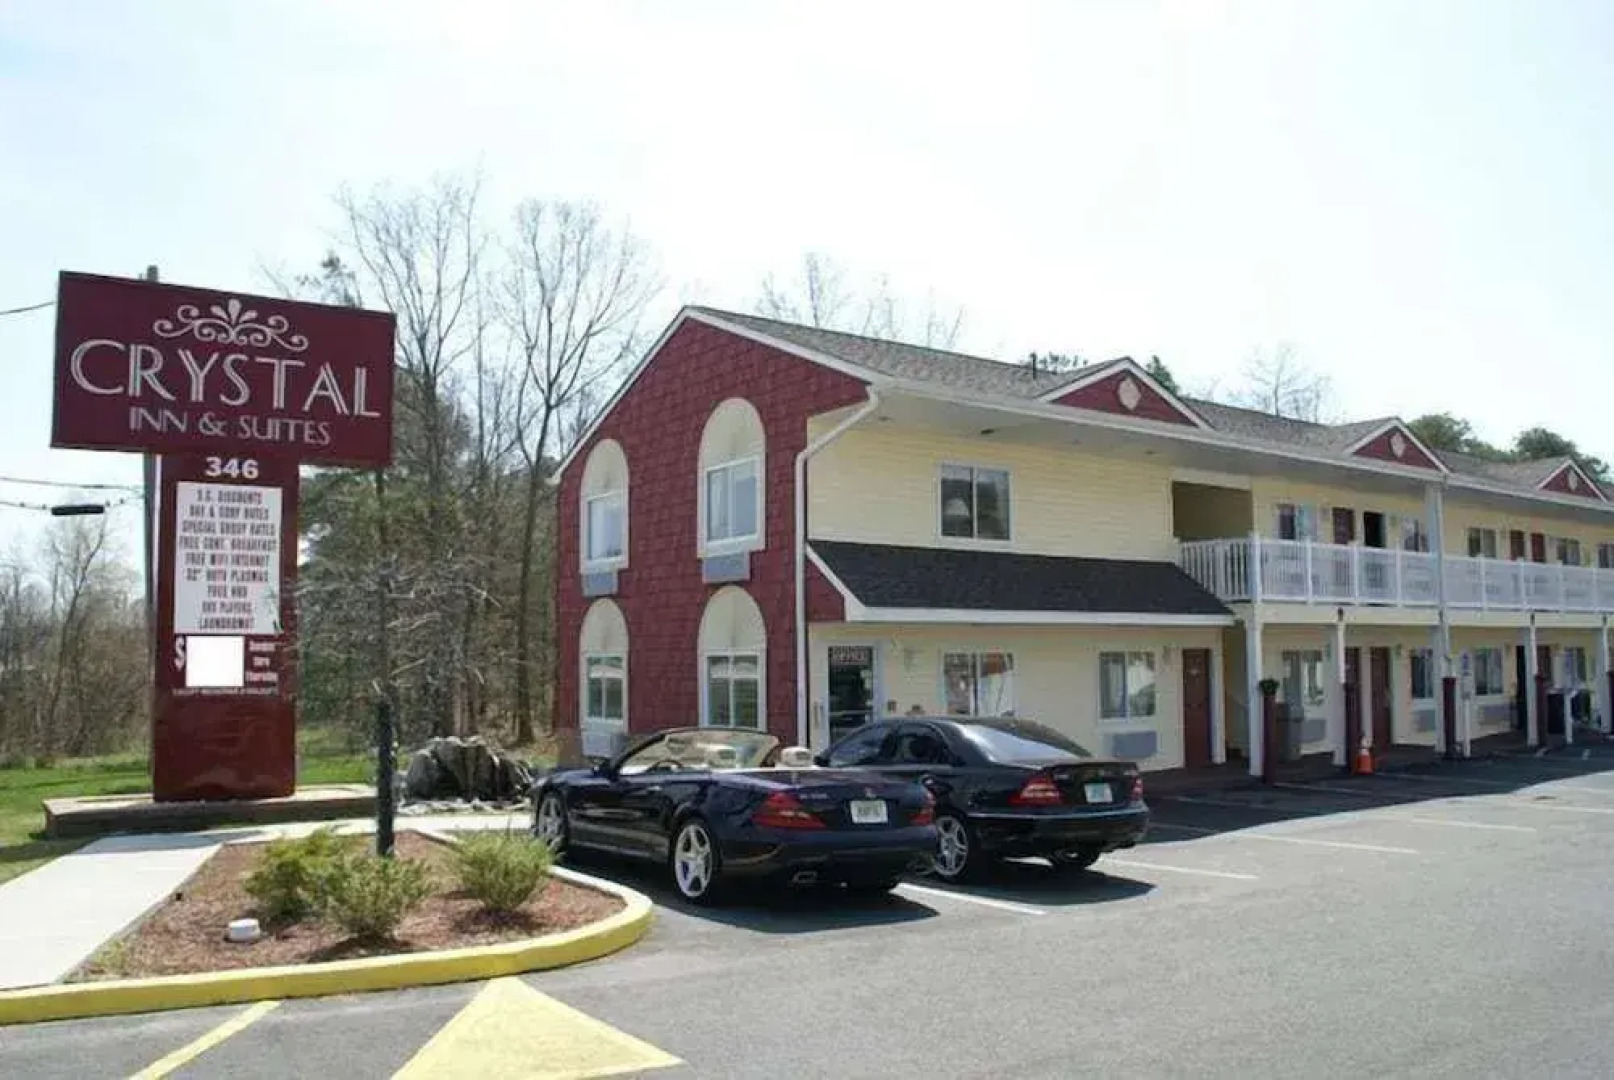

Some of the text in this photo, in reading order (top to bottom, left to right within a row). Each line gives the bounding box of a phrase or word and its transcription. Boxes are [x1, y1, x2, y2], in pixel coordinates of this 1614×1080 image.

[70, 338, 382, 418] CRYSTAL
[130, 406, 331, 446] INN & SUITES
[205, 457, 259, 479] 346
